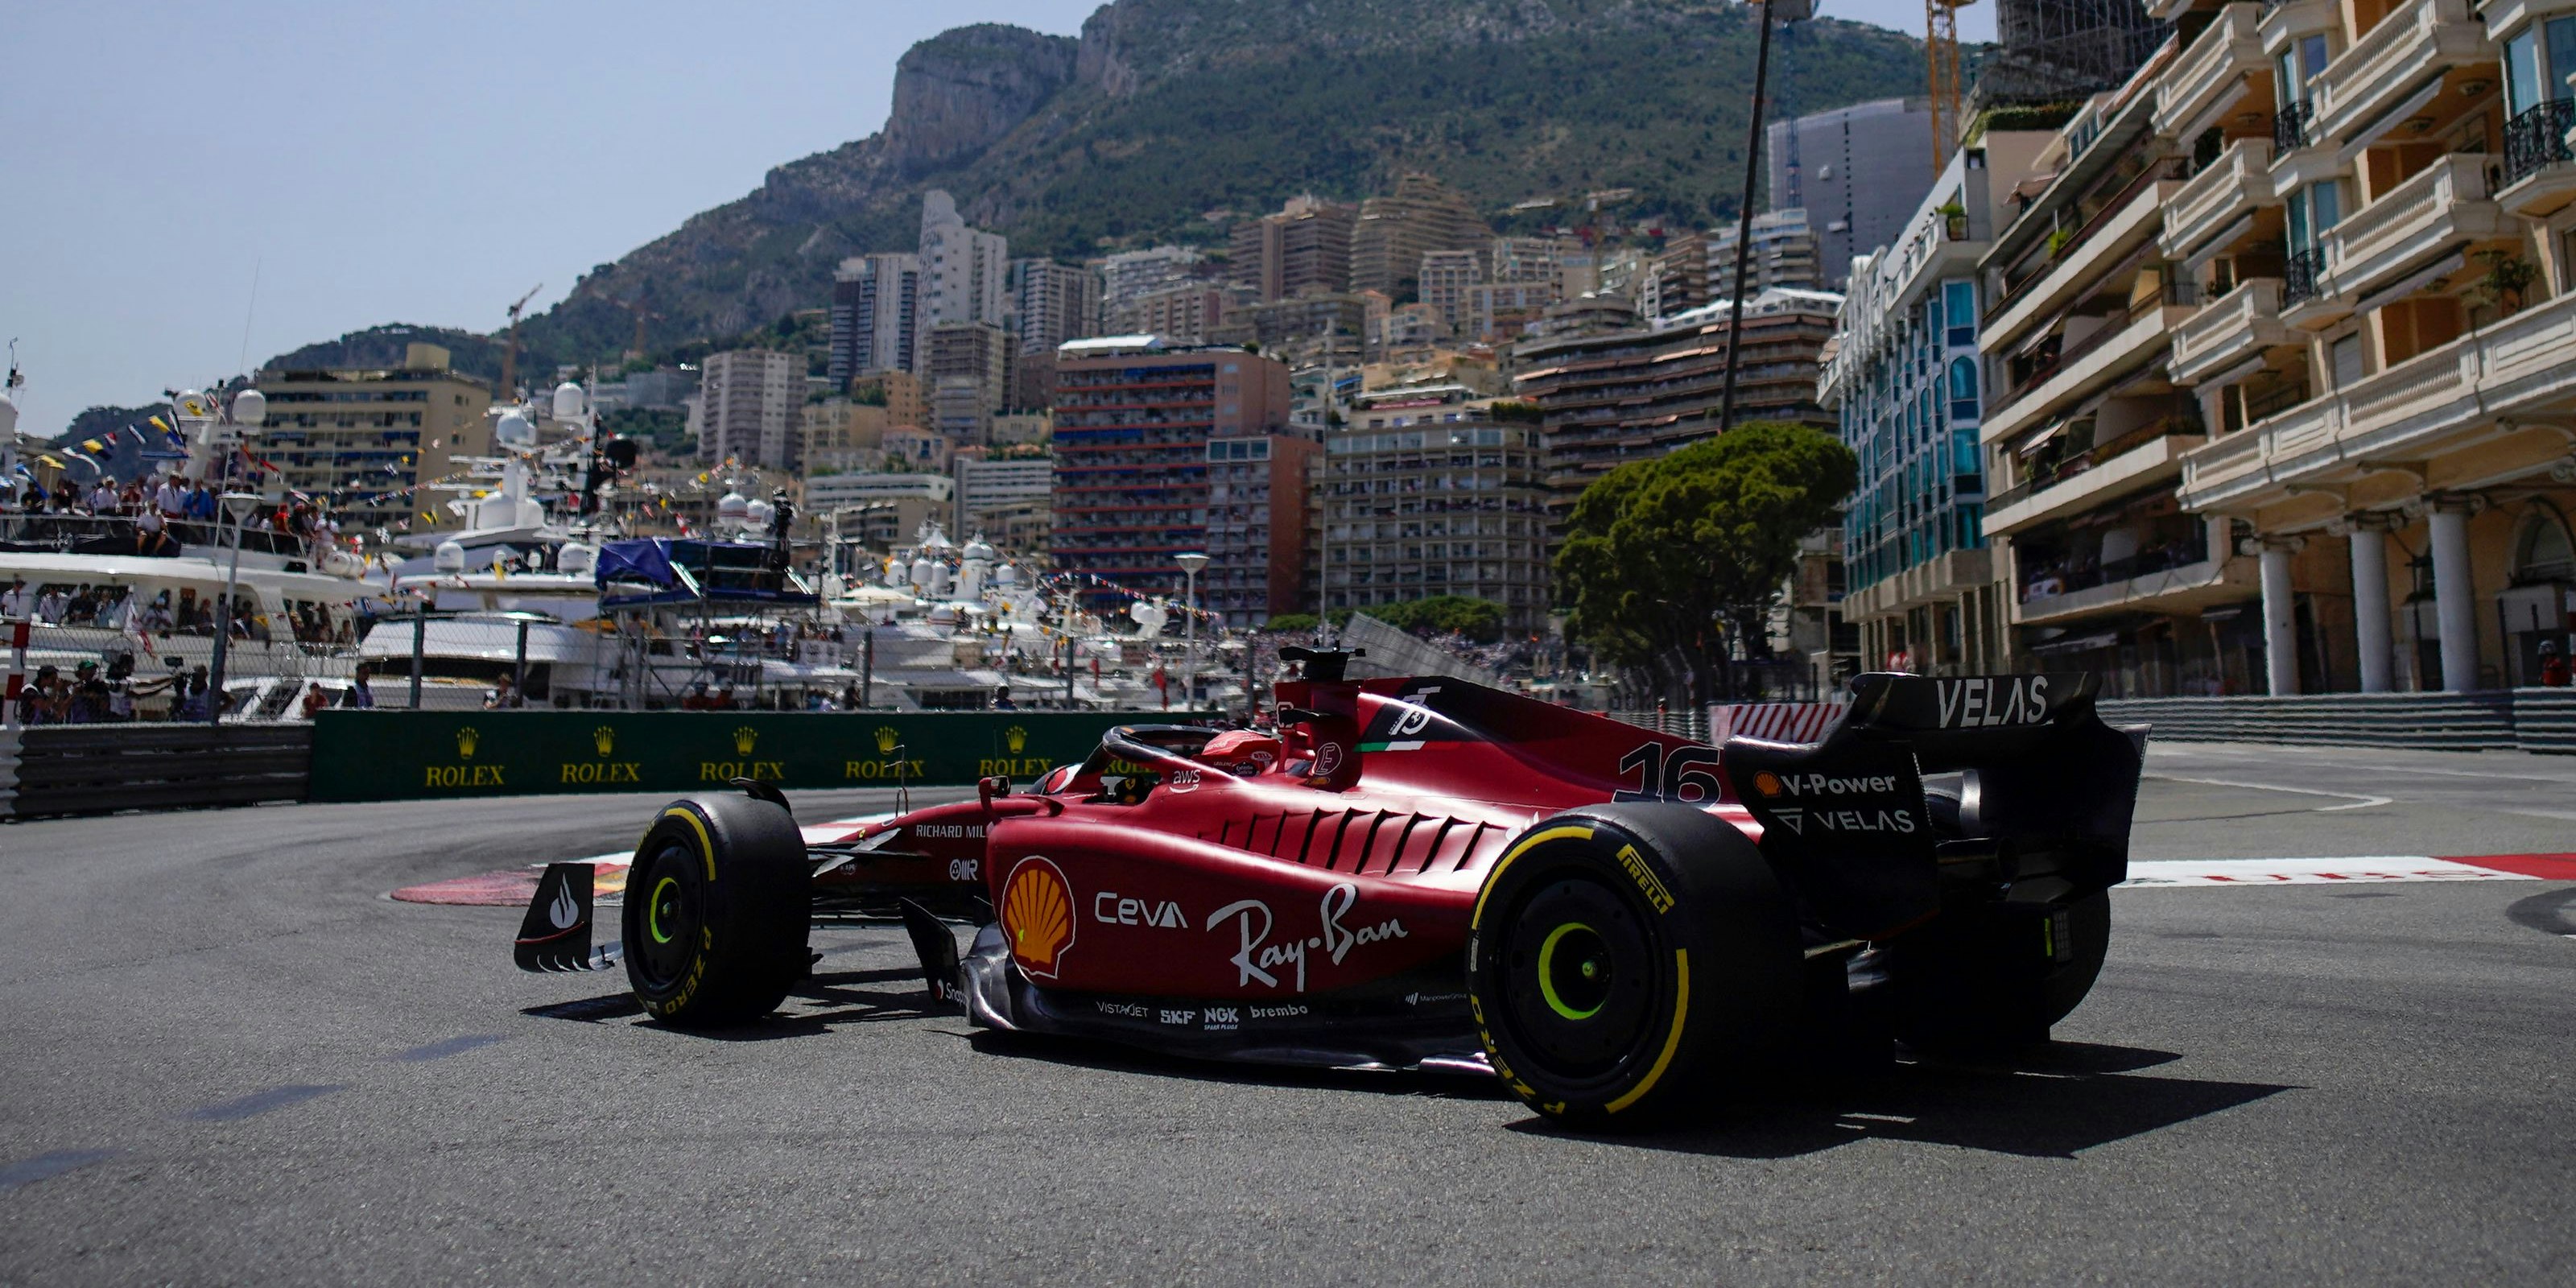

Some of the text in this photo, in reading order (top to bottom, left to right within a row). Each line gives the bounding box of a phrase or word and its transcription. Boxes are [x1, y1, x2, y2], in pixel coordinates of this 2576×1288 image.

[1936, 675, 2050, 729] VELAS
[426, 766, 506, 786] ROLEX
[562, 762, 641, 783] ROLEX
[700, 762, 785, 782] ROLEX
[845, 760, 925, 778] ROLEX
[979, 758, 1053, 776] ROLEX
[1173, 769, 1201, 785] aws
[1611, 742, 1720, 808] 16
[1781, 773, 1896, 797] V-Power
[916, 824, 986, 838] RICHARD MIL
[1812, 809, 1915, 833] VELAS
[1616, 843, 1674, 914] PIRELLI
[1160, 1009, 1196, 1025] SKF
[1204, 1007, 1240, 1024] NGK
[1249, 1004, 1308, 1018] brembo
